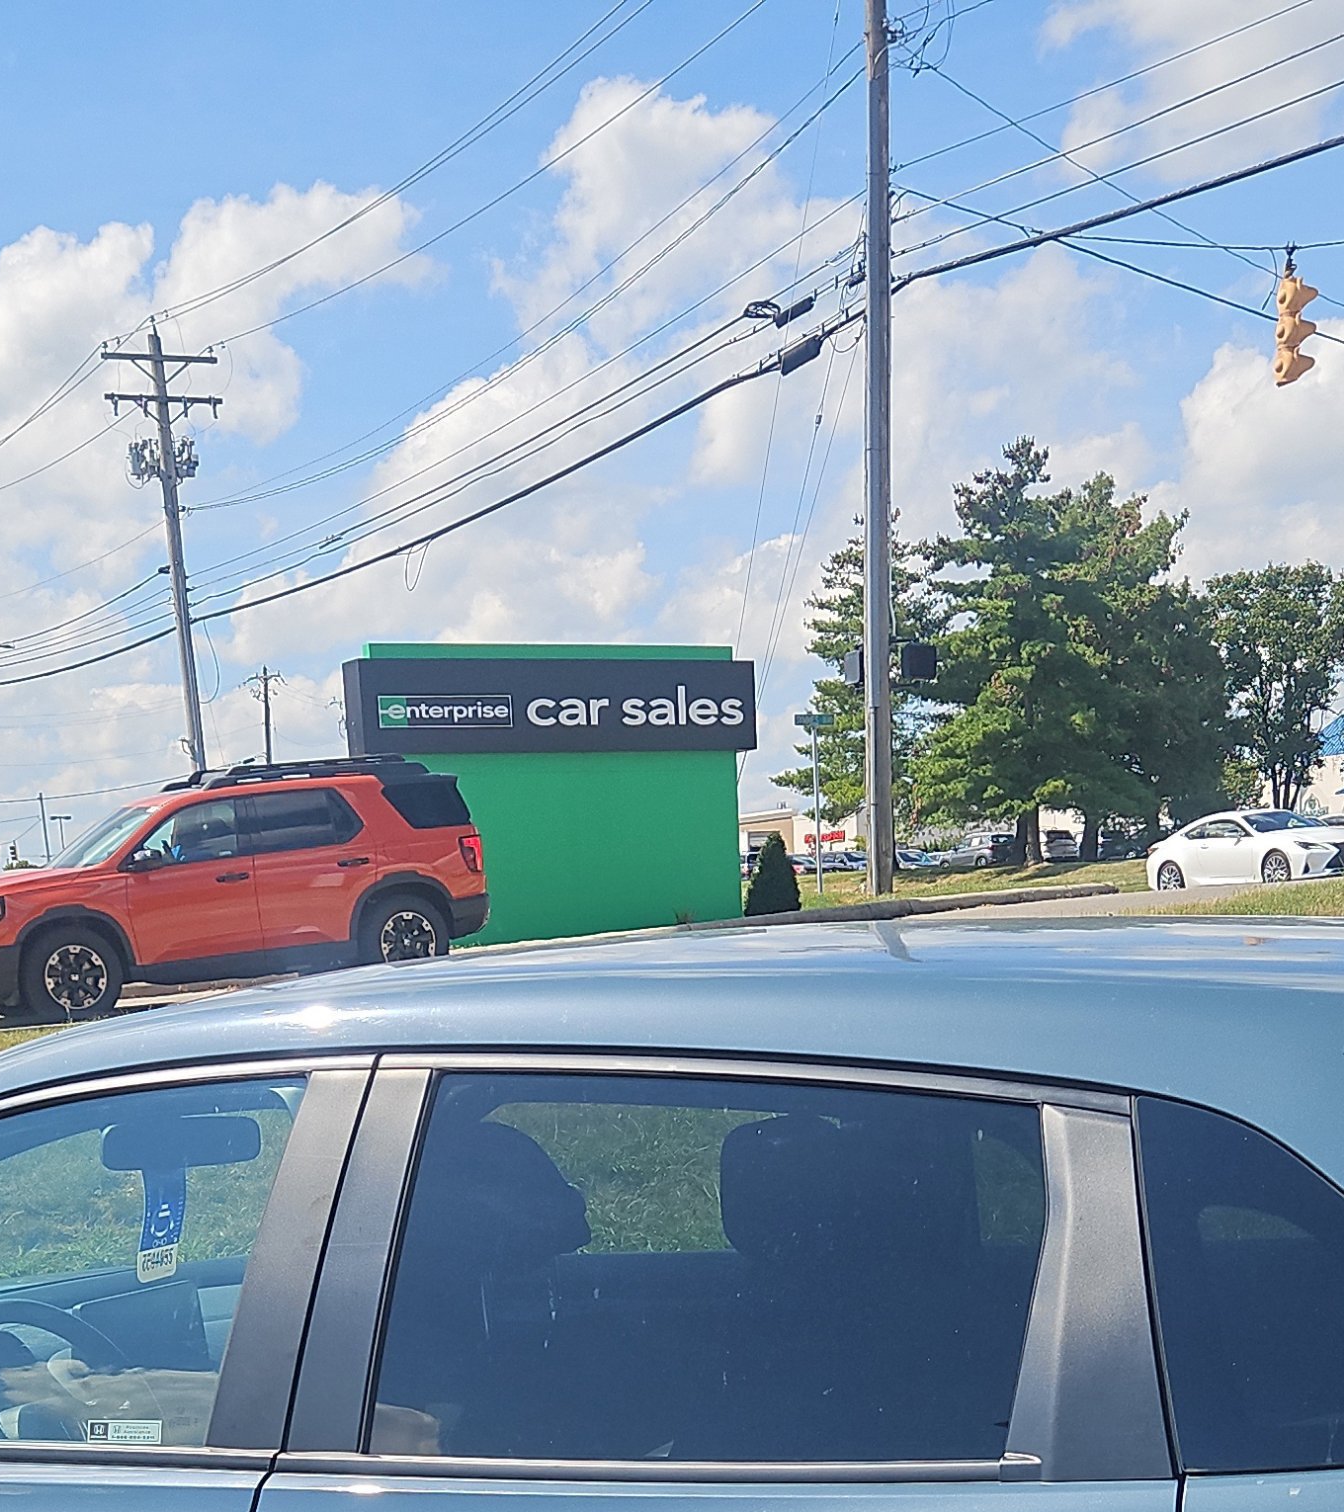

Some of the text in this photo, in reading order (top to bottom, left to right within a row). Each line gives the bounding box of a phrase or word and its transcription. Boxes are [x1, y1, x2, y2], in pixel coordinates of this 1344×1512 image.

[387, 685, 744, 726] enterprise car sales
